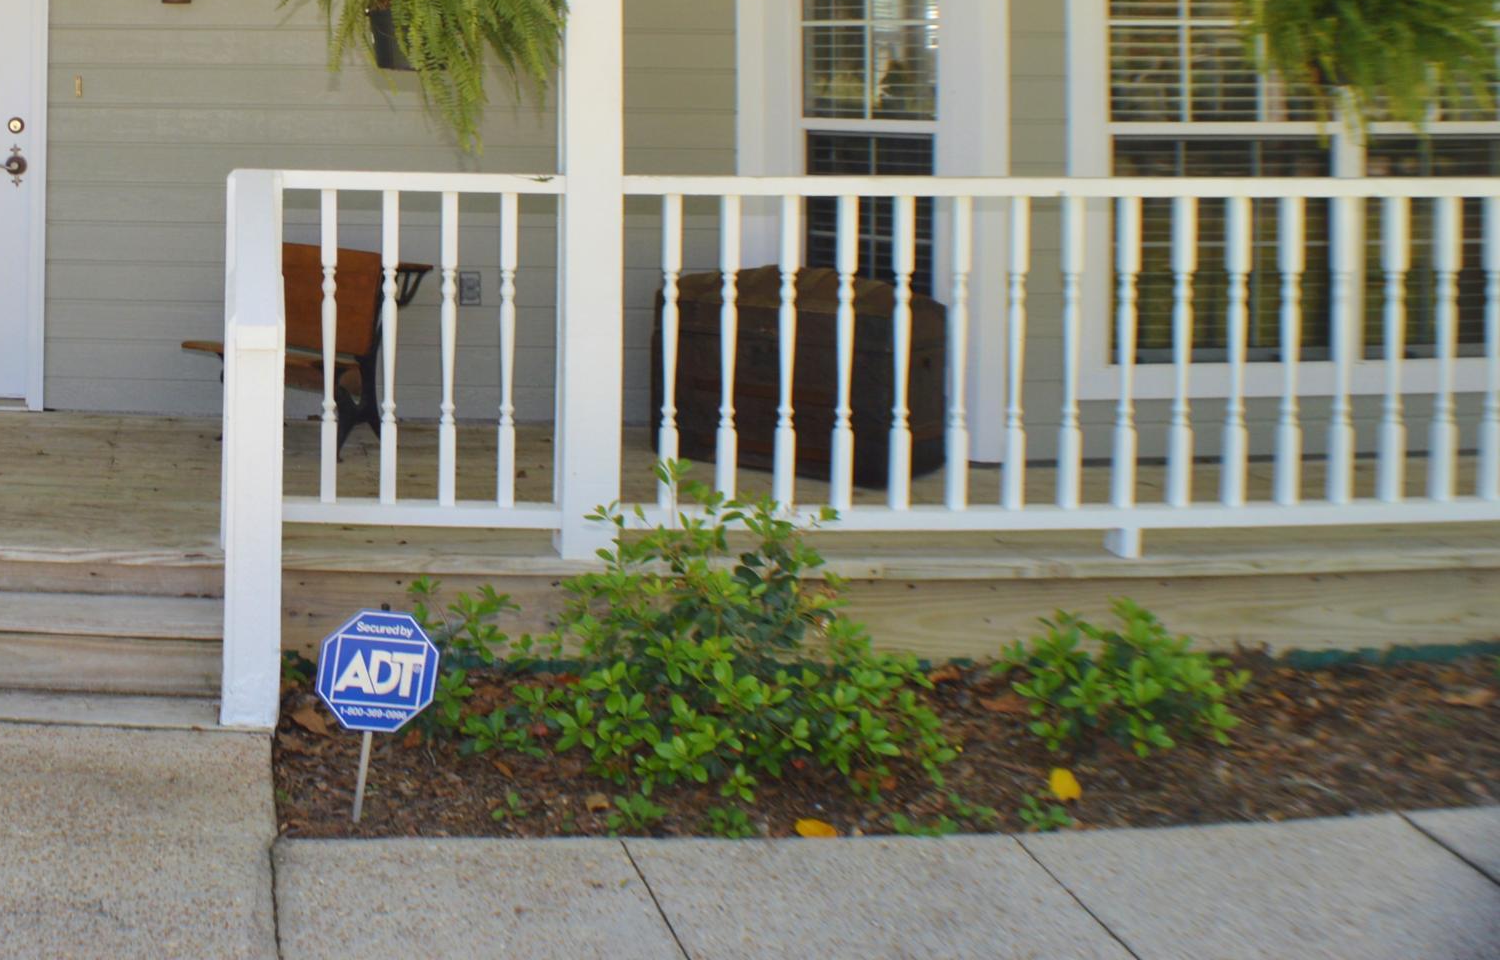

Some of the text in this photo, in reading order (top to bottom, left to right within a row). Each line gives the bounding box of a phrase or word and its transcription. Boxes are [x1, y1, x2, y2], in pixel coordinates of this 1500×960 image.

[356, 621, 414, 639] Secured by
[334, 648, 424, 698] ADT
